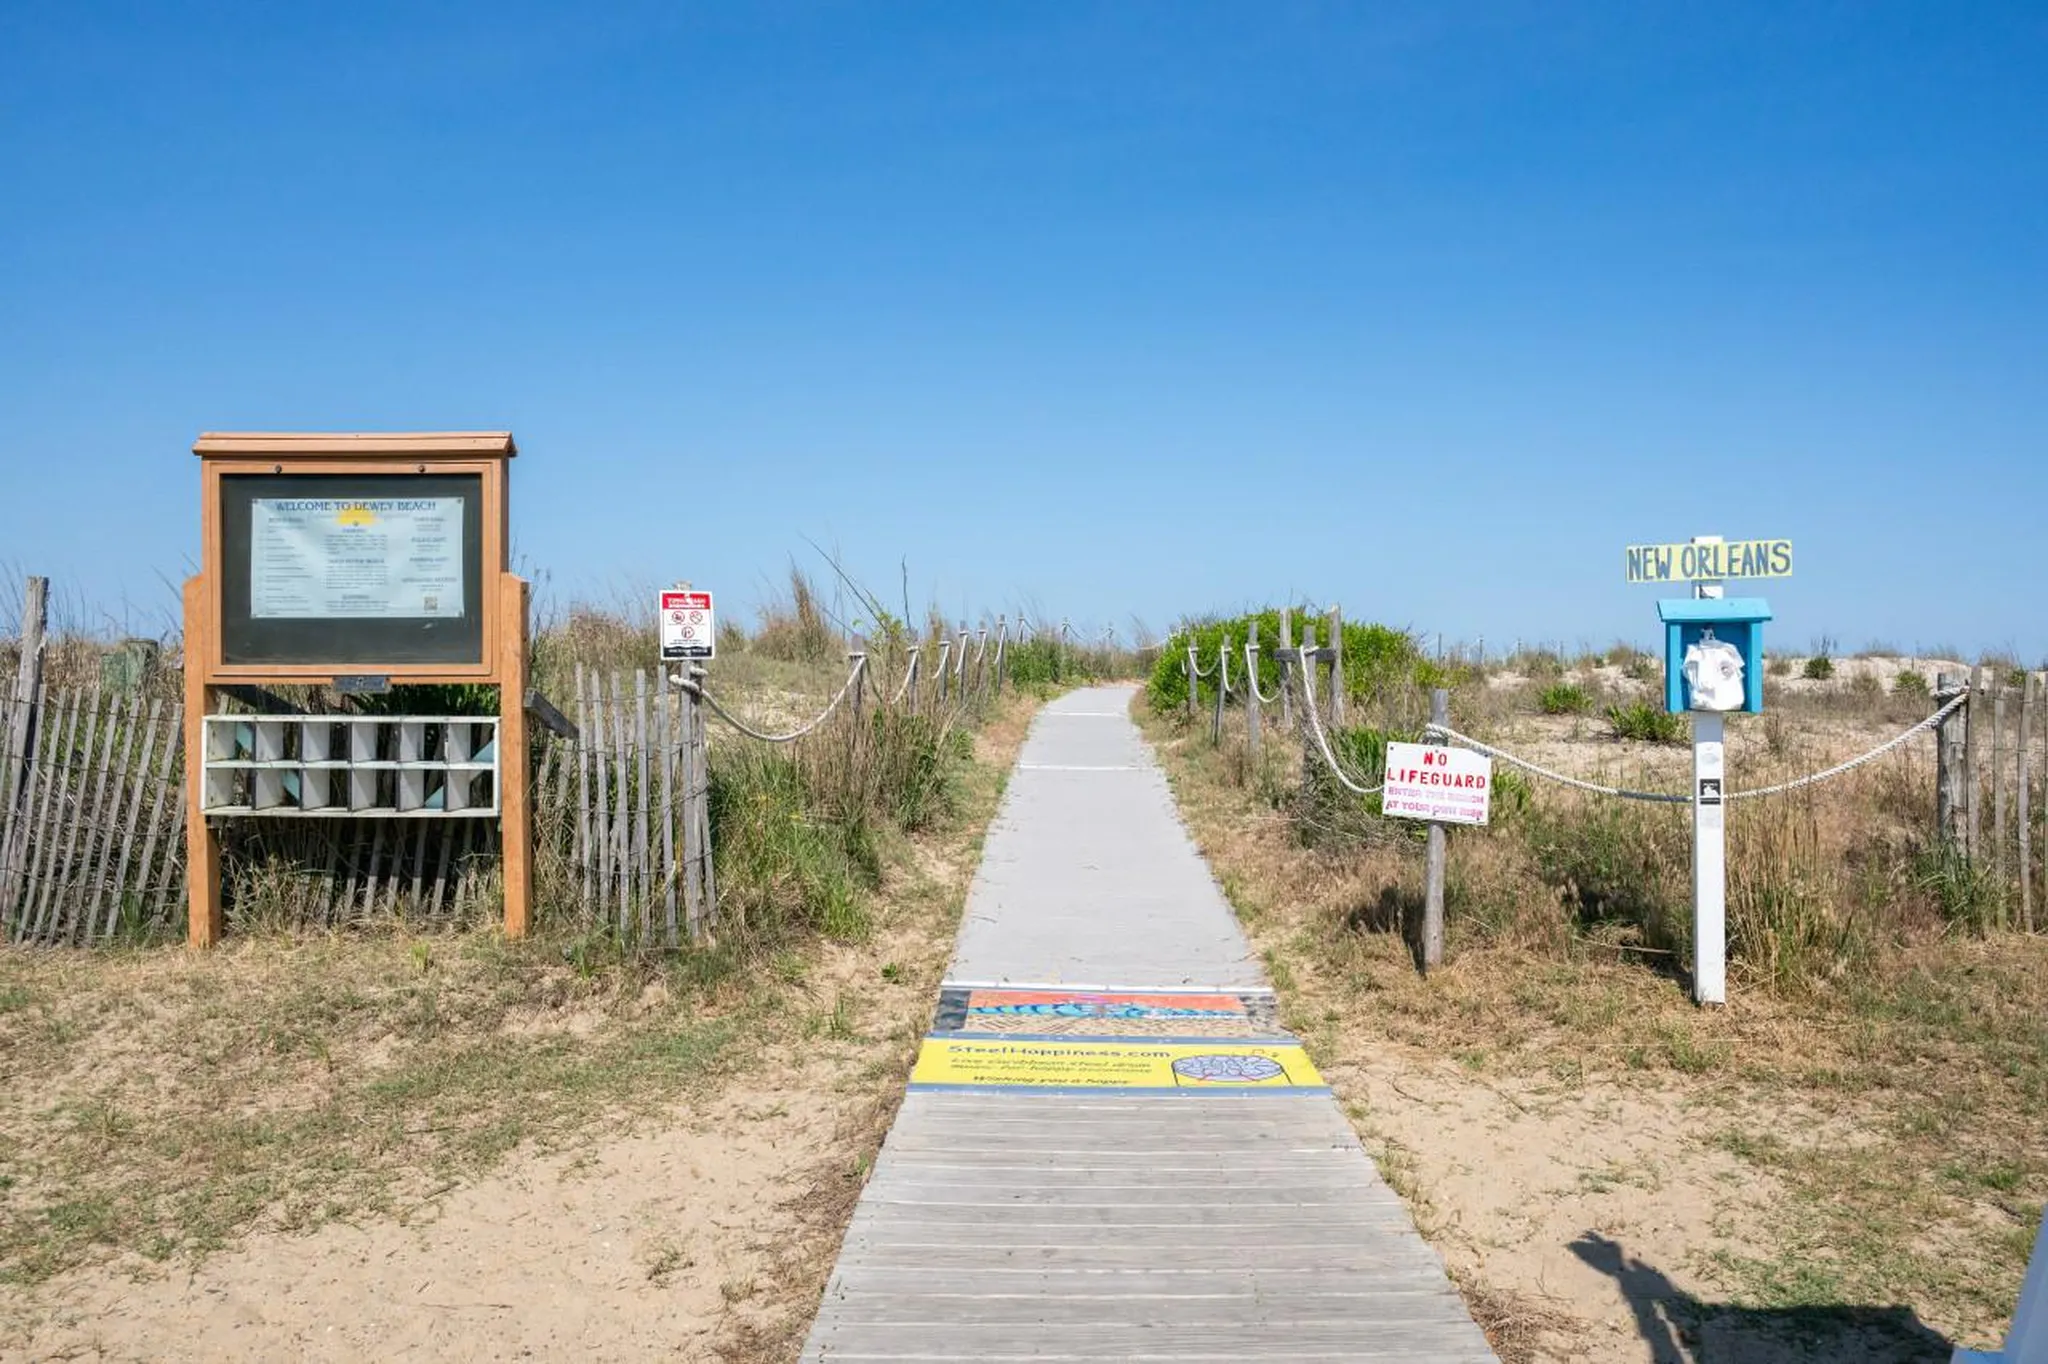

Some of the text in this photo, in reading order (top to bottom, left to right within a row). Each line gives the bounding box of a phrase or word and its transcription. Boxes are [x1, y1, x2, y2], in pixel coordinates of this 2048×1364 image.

[275, 501, 436, 512] WELCOME TO DEWEY BEACH
[1628, 542, 1791, 580] NEW ORLEANS
[1423, 752, 1447, 766] NO
[1387, 768, 1486, 789] LIFEGUARD
[1385, 800, 1399, 810] AT
